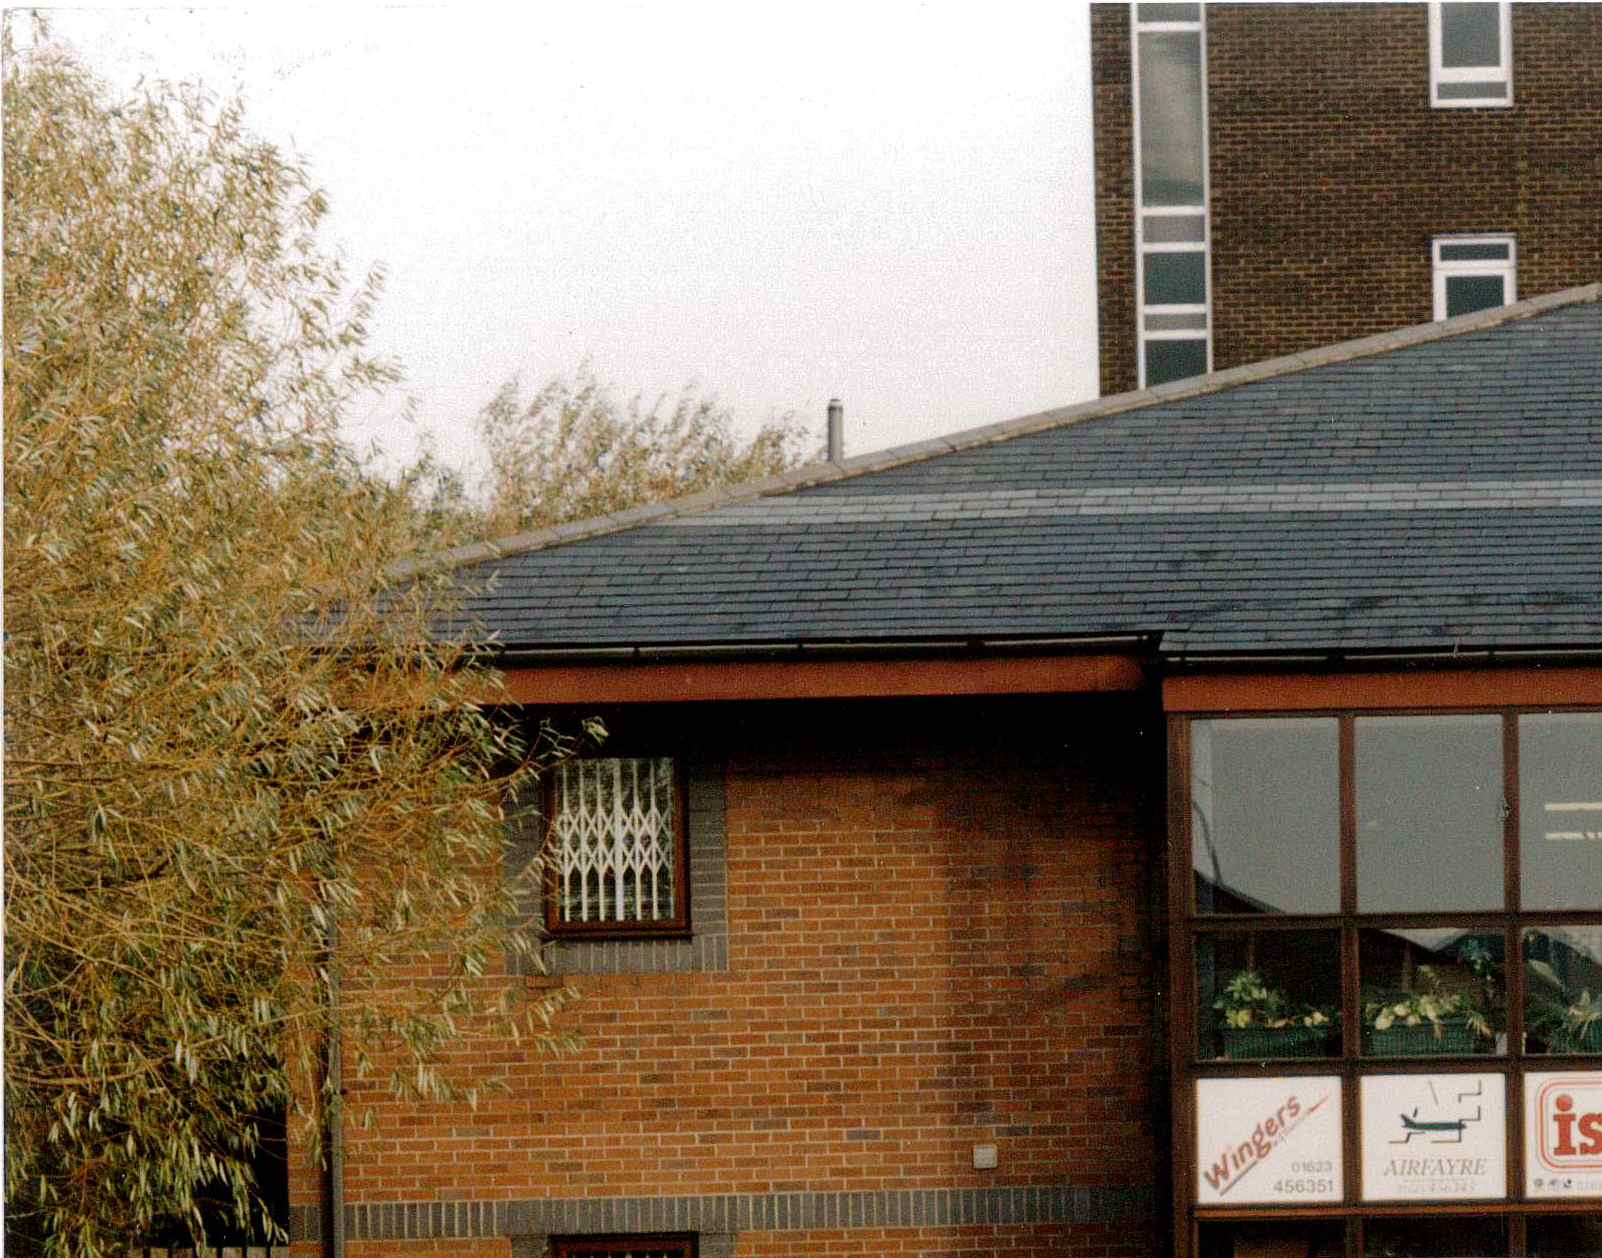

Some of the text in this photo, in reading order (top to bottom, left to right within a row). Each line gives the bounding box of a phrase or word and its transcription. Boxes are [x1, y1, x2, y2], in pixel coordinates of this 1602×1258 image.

[1203, 1095, 1301, 1191] Wingers
[1383, 1158, 1488, 1176] AIRFAYRE
[1273, 1179, 1334, 1193] 456351
